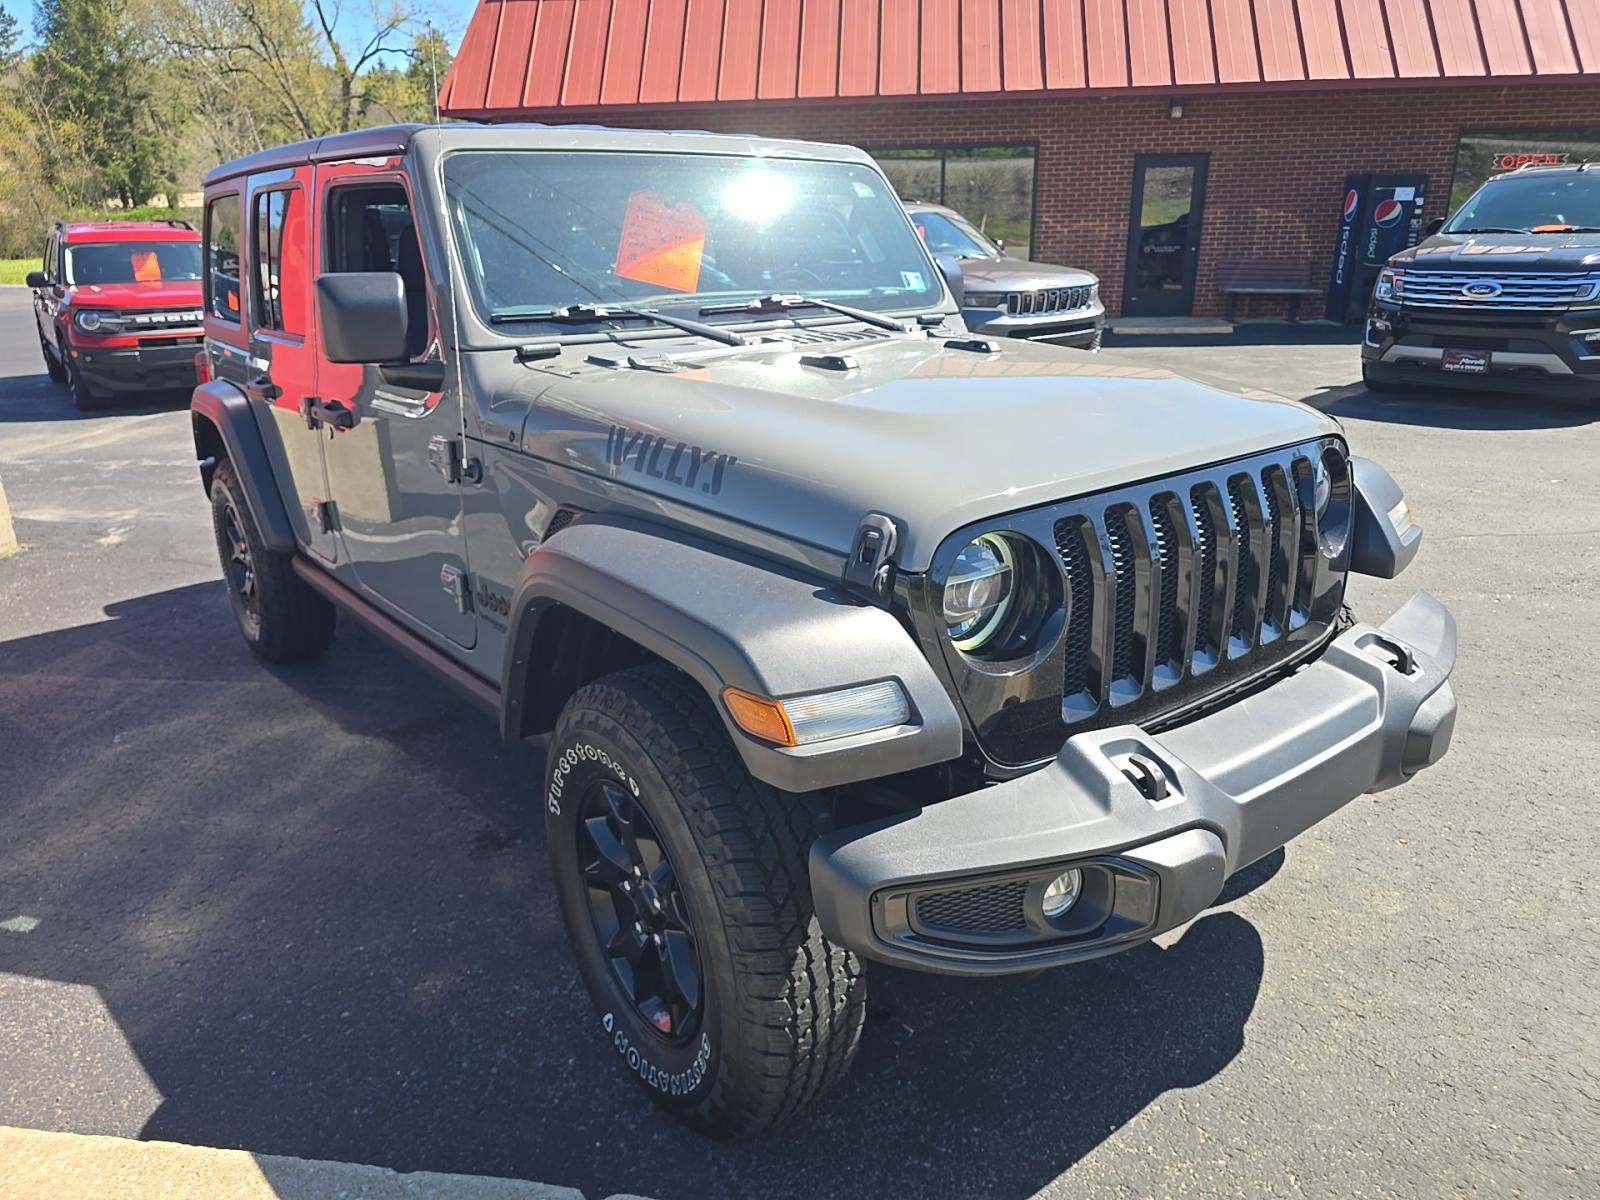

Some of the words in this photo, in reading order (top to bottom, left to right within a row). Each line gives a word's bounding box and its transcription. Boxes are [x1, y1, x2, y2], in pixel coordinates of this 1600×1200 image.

[1501, 153, 1558, 170] OPEN
[606, 424, 738, 496] WILLYS
[548, 742, 626, 816] Firestone
[614, 1032, 711, 1096] DESTINATION
